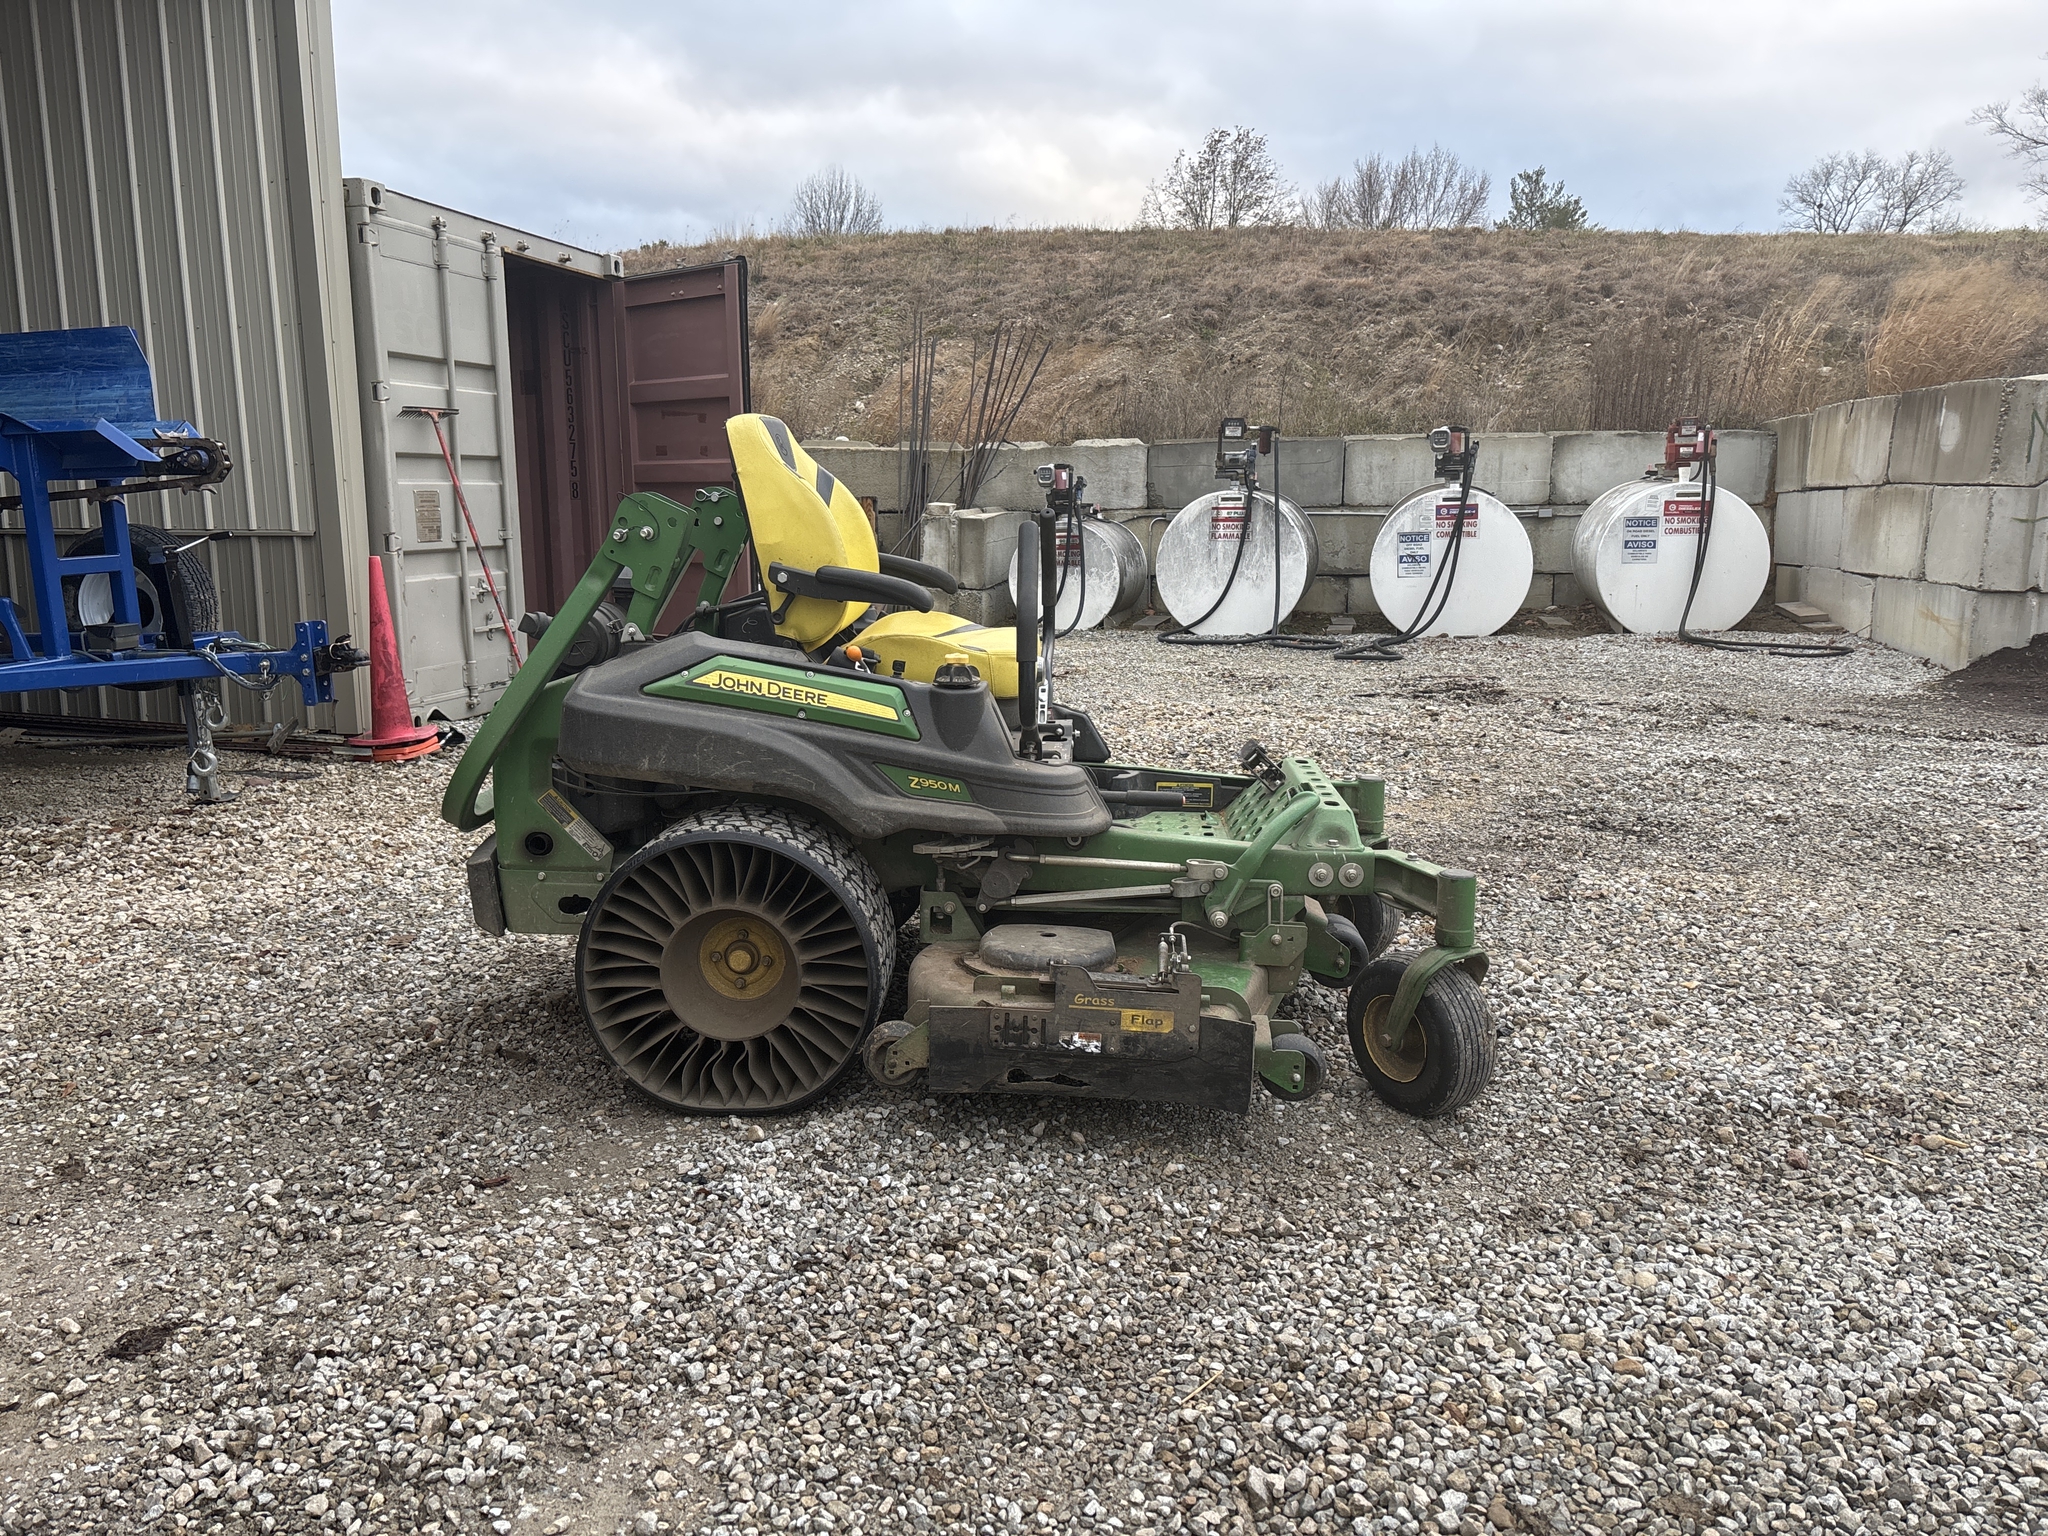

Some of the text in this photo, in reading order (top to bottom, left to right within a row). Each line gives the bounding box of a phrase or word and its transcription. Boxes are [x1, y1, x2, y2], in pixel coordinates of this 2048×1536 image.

[1435, 521, 1446, 529] NO
[1447, 520, 1478, 528] SMKING
[1625, 519, 1657, 527] NOTICE
[1664, 517, 1676, 525] NO
[1211, 523, 1221, 531] NO
[1211, 532, 1251, 540] FLAMMALE
[1400, 534, 1429, 542] NOTICE
[1435, 530, 1477, 539] COMTIBLE
[1626, 540, 1654, 548] AVISO
[711, 673, 828, 706] JOHN DEERE
[1074, 993, 1116, 1007] Grass
[1131, 1014, 1164, 1029] Flap
